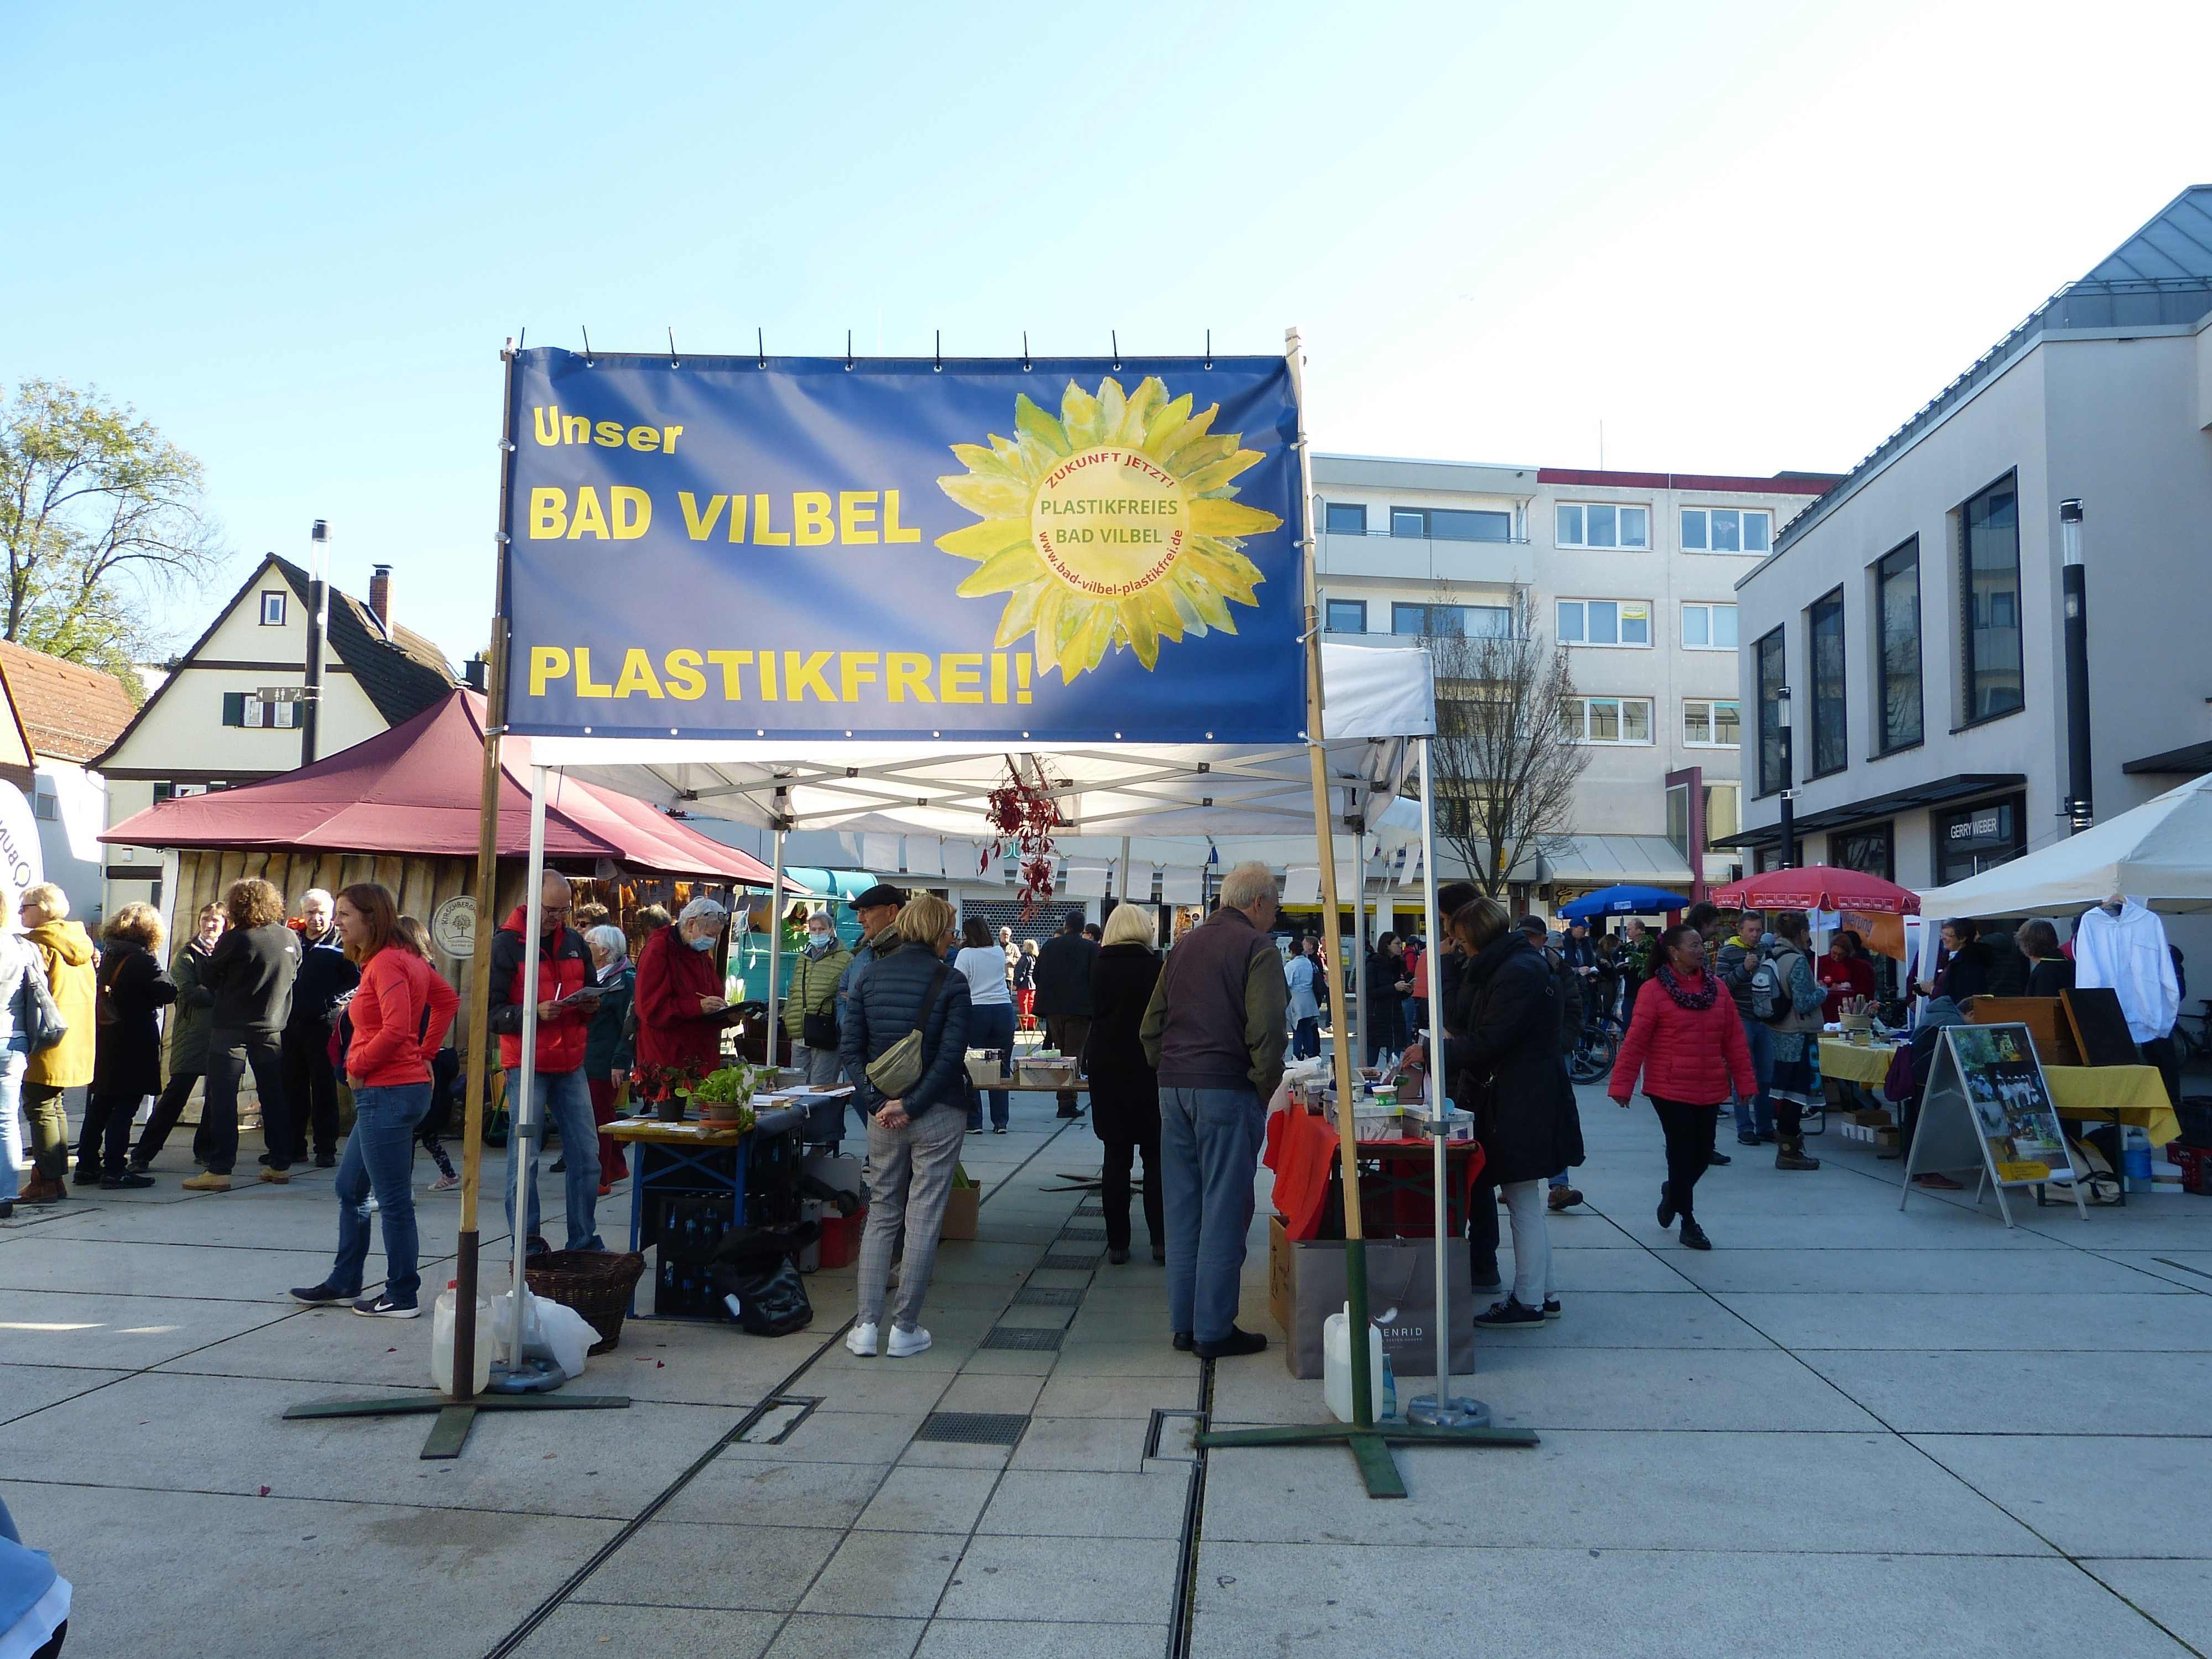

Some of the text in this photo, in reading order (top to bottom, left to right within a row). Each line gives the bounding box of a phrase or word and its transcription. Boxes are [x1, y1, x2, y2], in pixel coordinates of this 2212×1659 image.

[534, 406, 684, 454] Unser
[1045, 452, 1175, 489] ZUKUNFT JETZT!
[529, 487, 922, 546] BAD VILBEL
[1041, 499, 1178, 515] PLASTIKFREIES
[1056, 529, 1162, 544] BAD VILBEL
[1039, 529, 1183, 596] www.bad-vilbel-plastikfrei.de
[529, 646, 1034, 705] PLASTIKFREI!
[1950, 818, 1997, 839] GERRY WEBER
[441, 901, 477, 925] KIRSCHBERGH
[1383, 1327, 1422, 1337] ENRID
